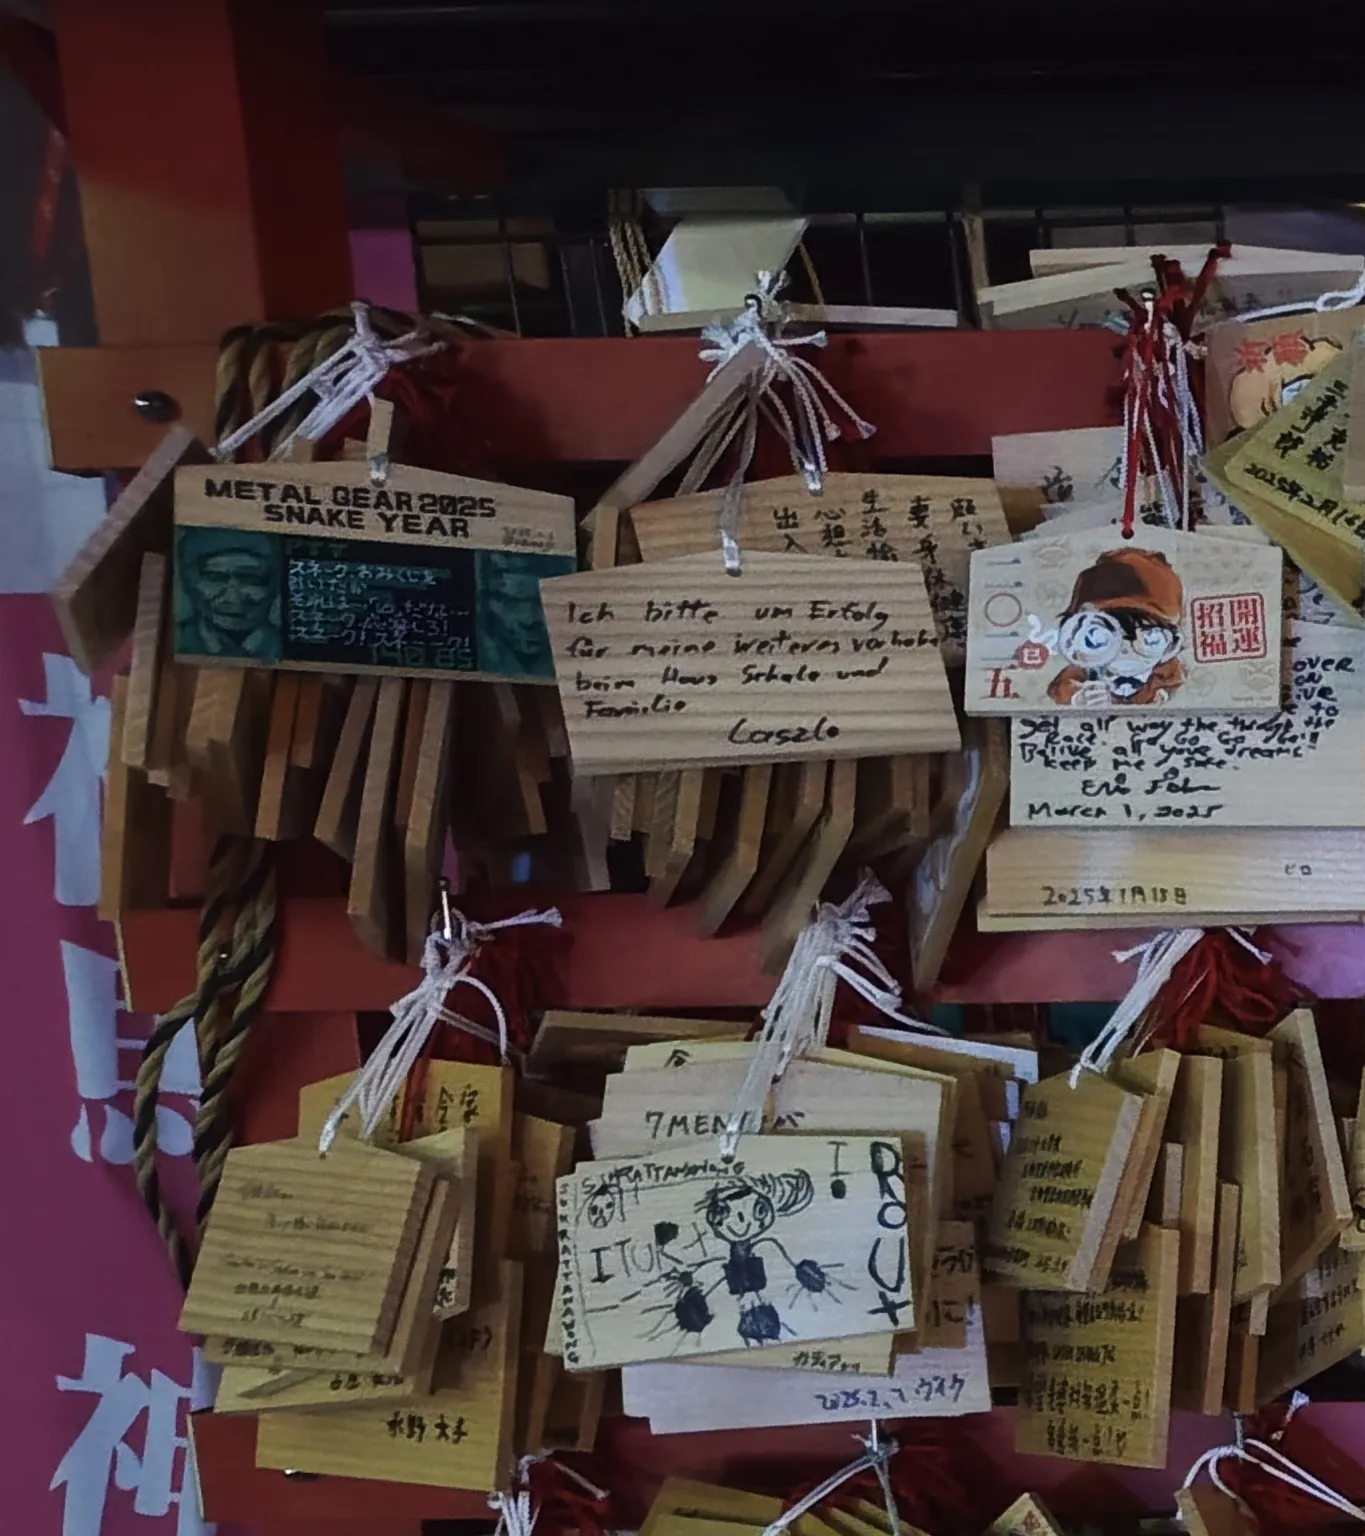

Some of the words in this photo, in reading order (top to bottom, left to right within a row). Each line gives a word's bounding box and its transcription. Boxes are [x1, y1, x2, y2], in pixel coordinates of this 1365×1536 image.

[205, 478, 322, 506] METAL
[332, 485, 416, 512] GEAR
[419, 493, 496, 517] 2025
[264, 504, 365, 529] SNAKE
[378, 508, 470, 538] YEAR
[567, 601, 614, 623] Ich
[645, 600, 719, 623] bitte
[754, 604, 794, 621] um
[808, 600, 889, 626] Erfolg
[1197, 603, 1228, 656] 招福
[1230, 596, 1262, 653] 開運
[835, 657, 889, 680] und
